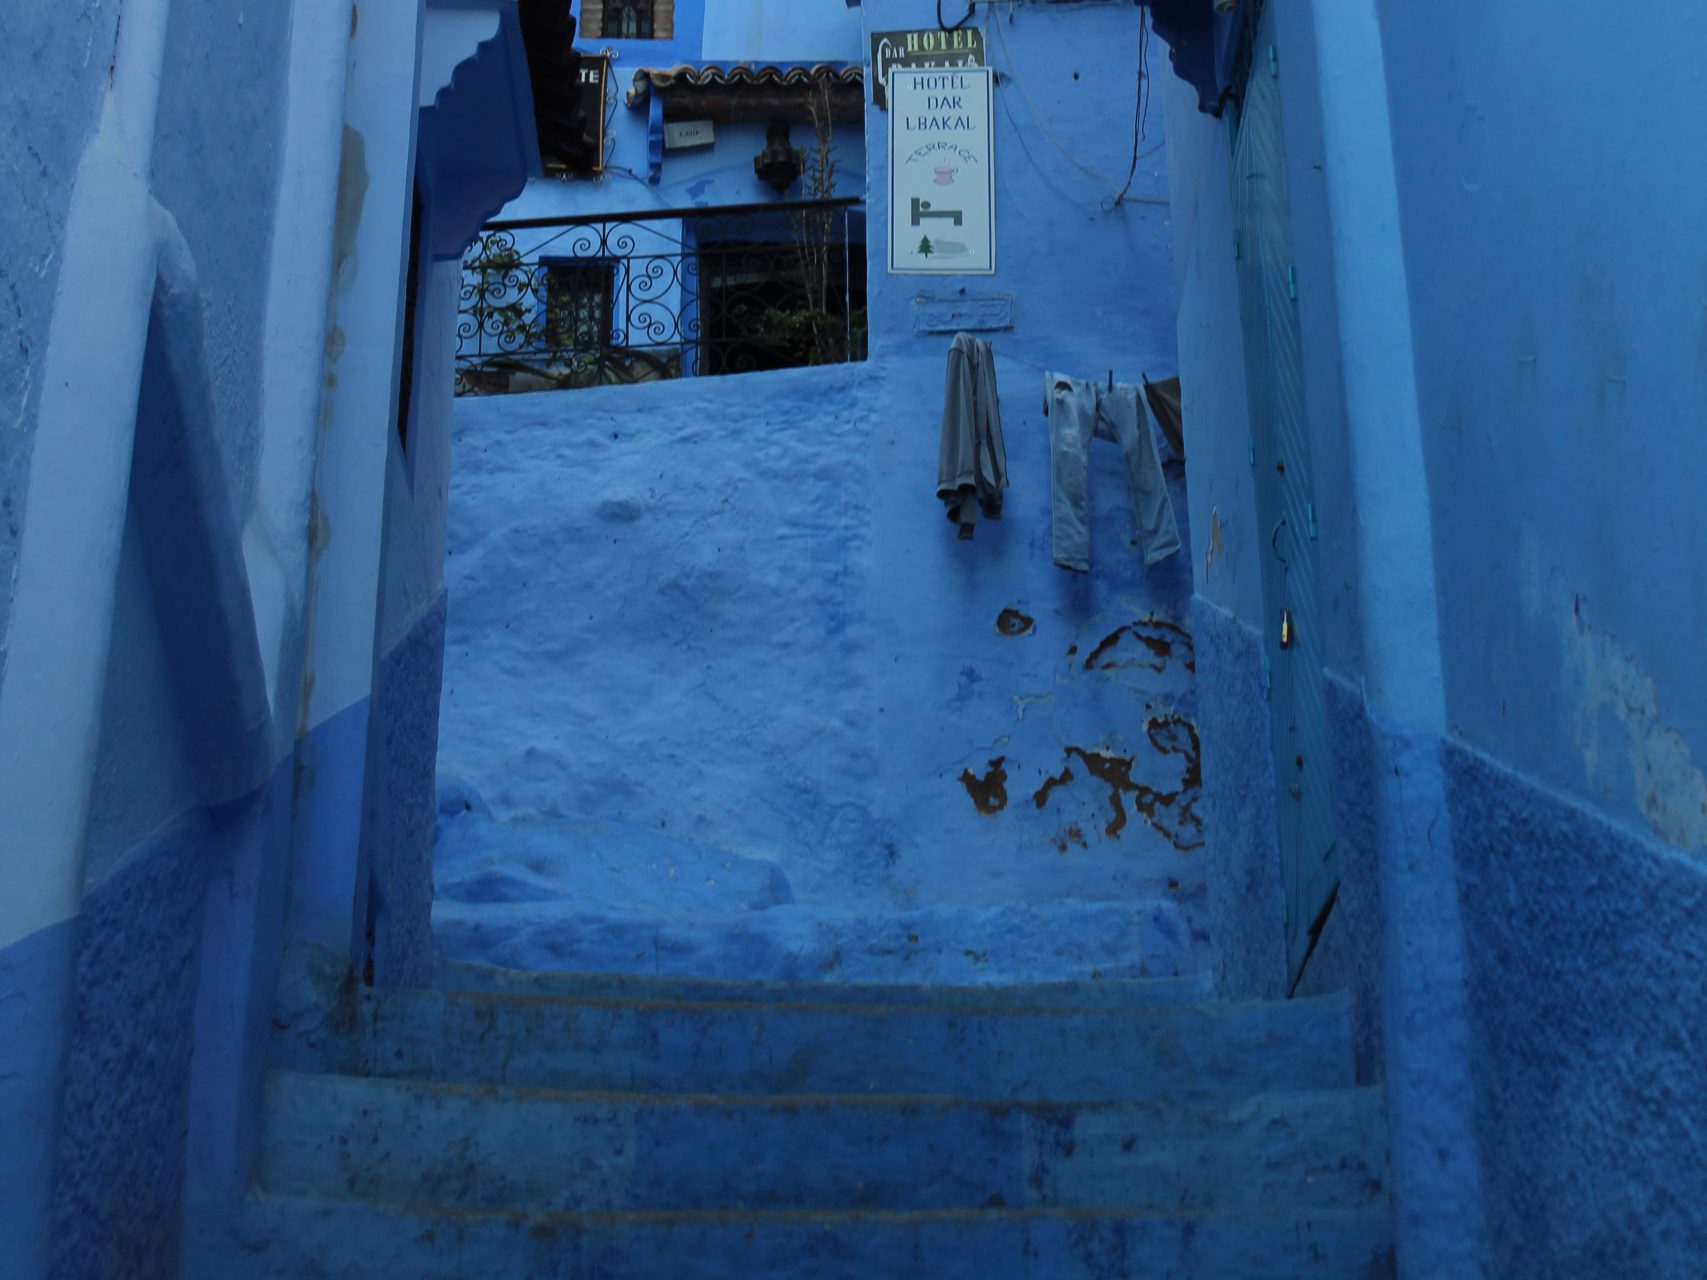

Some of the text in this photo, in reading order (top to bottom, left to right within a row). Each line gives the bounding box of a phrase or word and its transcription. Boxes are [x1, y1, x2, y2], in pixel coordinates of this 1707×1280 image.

[906, 30, 977, 52] HOTEL
[885, 47, 905, 58] DAR
[577, 69, 599, 83] TE
[928, 96, 962, 110] DAR
[906, 116, 976, 131] LBAKAL
[905, 142, 978, 164] TERRACE
